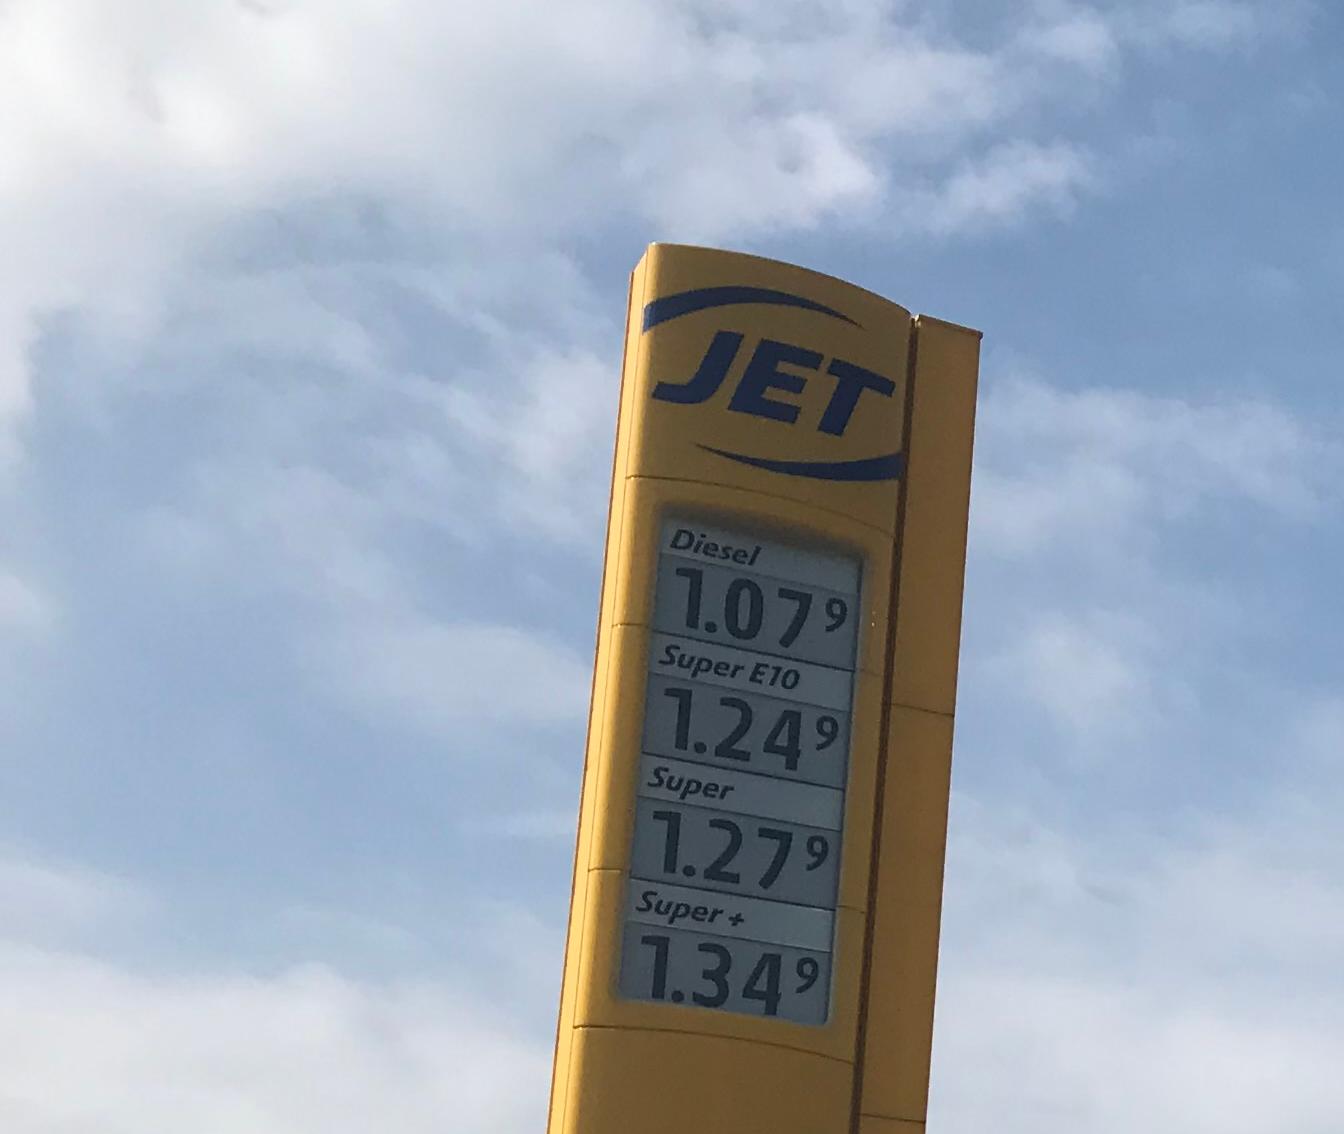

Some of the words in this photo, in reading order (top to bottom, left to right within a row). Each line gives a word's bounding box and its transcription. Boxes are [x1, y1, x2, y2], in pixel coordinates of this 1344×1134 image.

[652, 330, 896, 436] JET
[669, 528, 762, 566] Diesel
[658, 644, 745, 679] Super
[749, 661, 801, 691] E10
[647, 766, 735, 801] Super
[635, 890, 724, 925] Super
